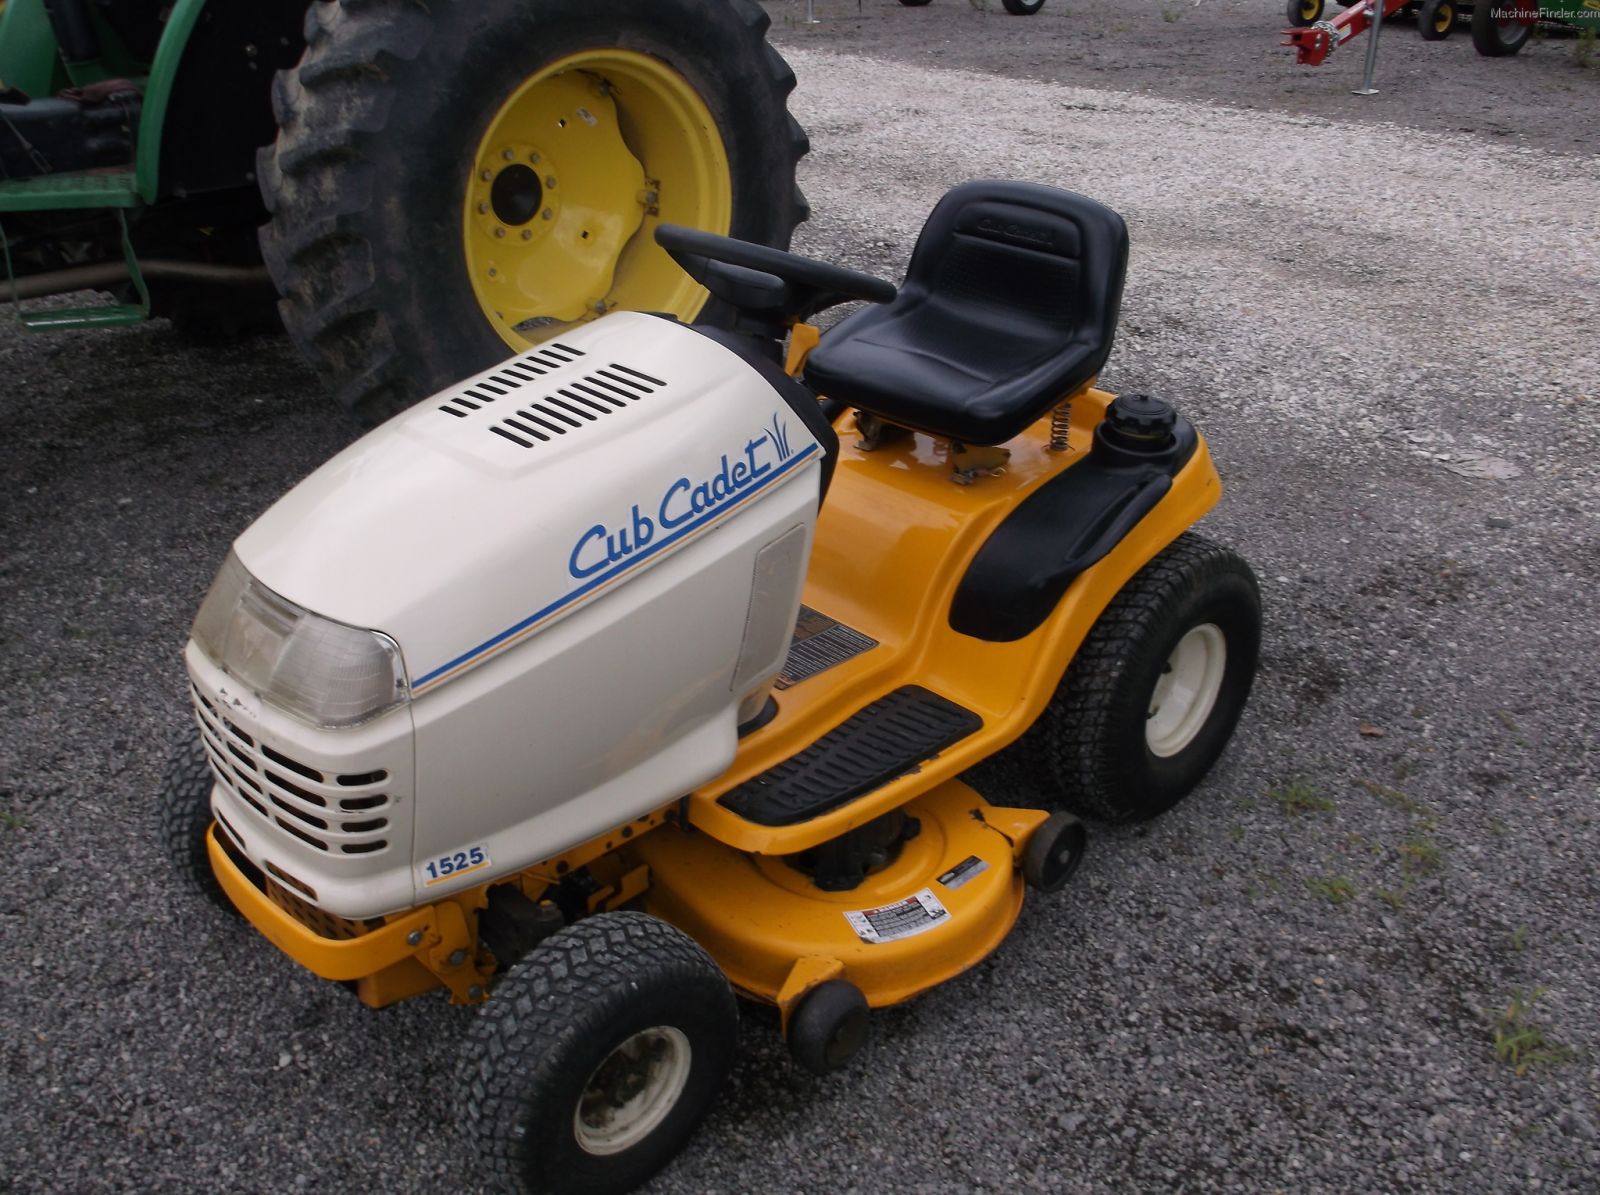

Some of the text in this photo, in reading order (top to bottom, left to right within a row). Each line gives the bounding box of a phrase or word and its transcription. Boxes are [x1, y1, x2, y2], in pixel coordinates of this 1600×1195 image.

[568, 435, 772, 579] Cub Cadet
[426, 847, 484, 878] 1525
